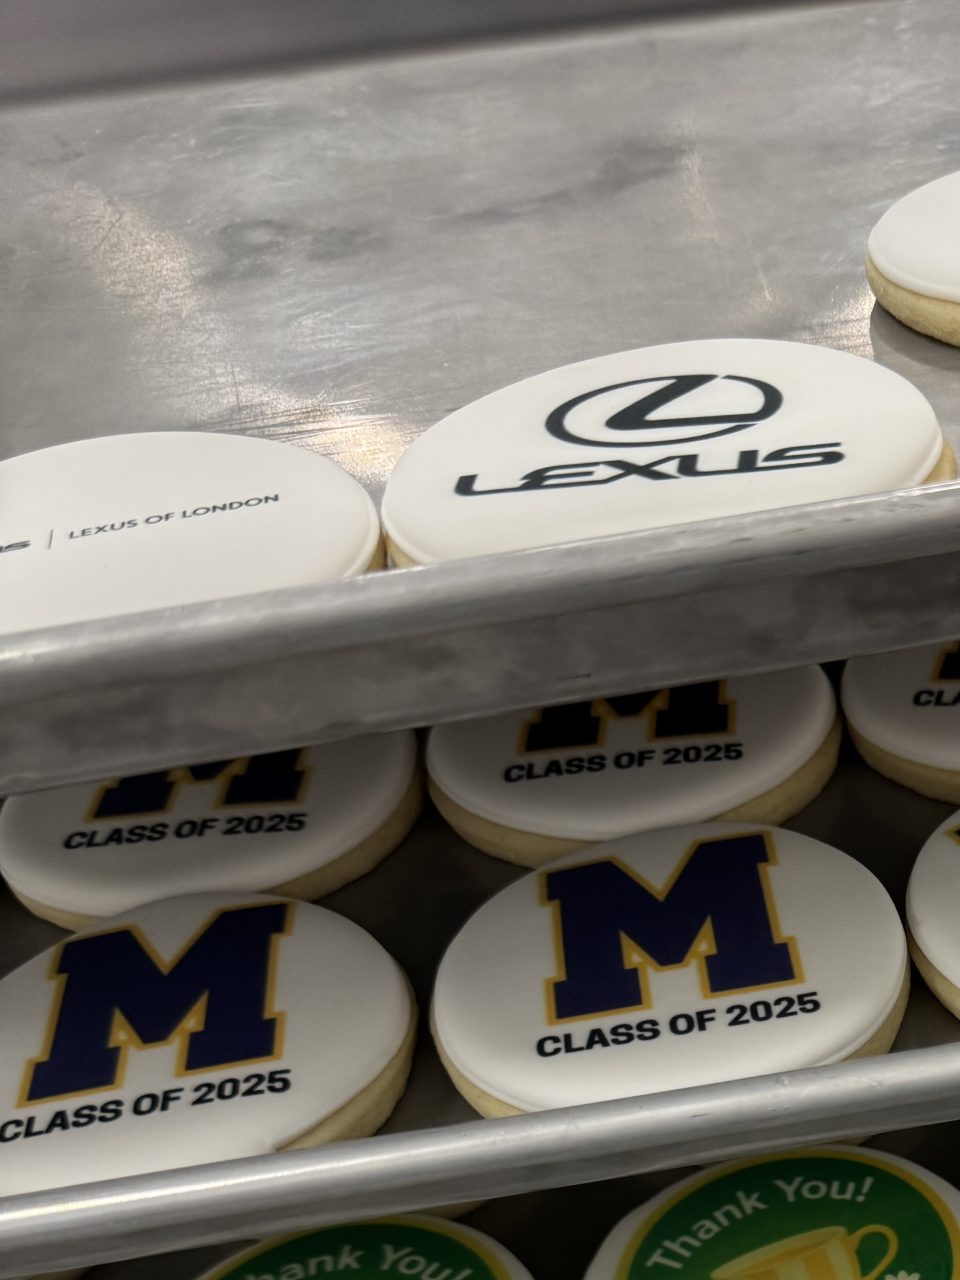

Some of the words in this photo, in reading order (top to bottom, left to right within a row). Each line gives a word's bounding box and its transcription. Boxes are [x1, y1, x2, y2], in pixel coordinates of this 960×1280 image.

[454, 442, 846, 496] LEXUS
[69, 519, 138, 540] LEXUS
[145, 512, 175, 525] OF
[182, 494, 280, 519] LONDON
[503, 753, 606, 784] CLASS
[613, 748, 656, 771] OF
[663, 742, 744, 766] 2025
[63, 821, 169, 850] CLASS
[174, 817, 217, 840] OF
[225, 812, 309, 835] 2025
[538, 829, 805, 1026] M
[16, 901, 295, 1108] M
[536, 1018, 662, 1058] CLASS
[668, 1008, 719, 1036] OF
[726, 990, 822, 1028] 2025
[0, 1098, 125, 1143] CLASS
[132, 1086, 184, 1117] OF
[191, 1068, 292, 1105] 2025
[645, 1190, 768, 1270] Thank
[773, 1176, 874, 1203] You!
